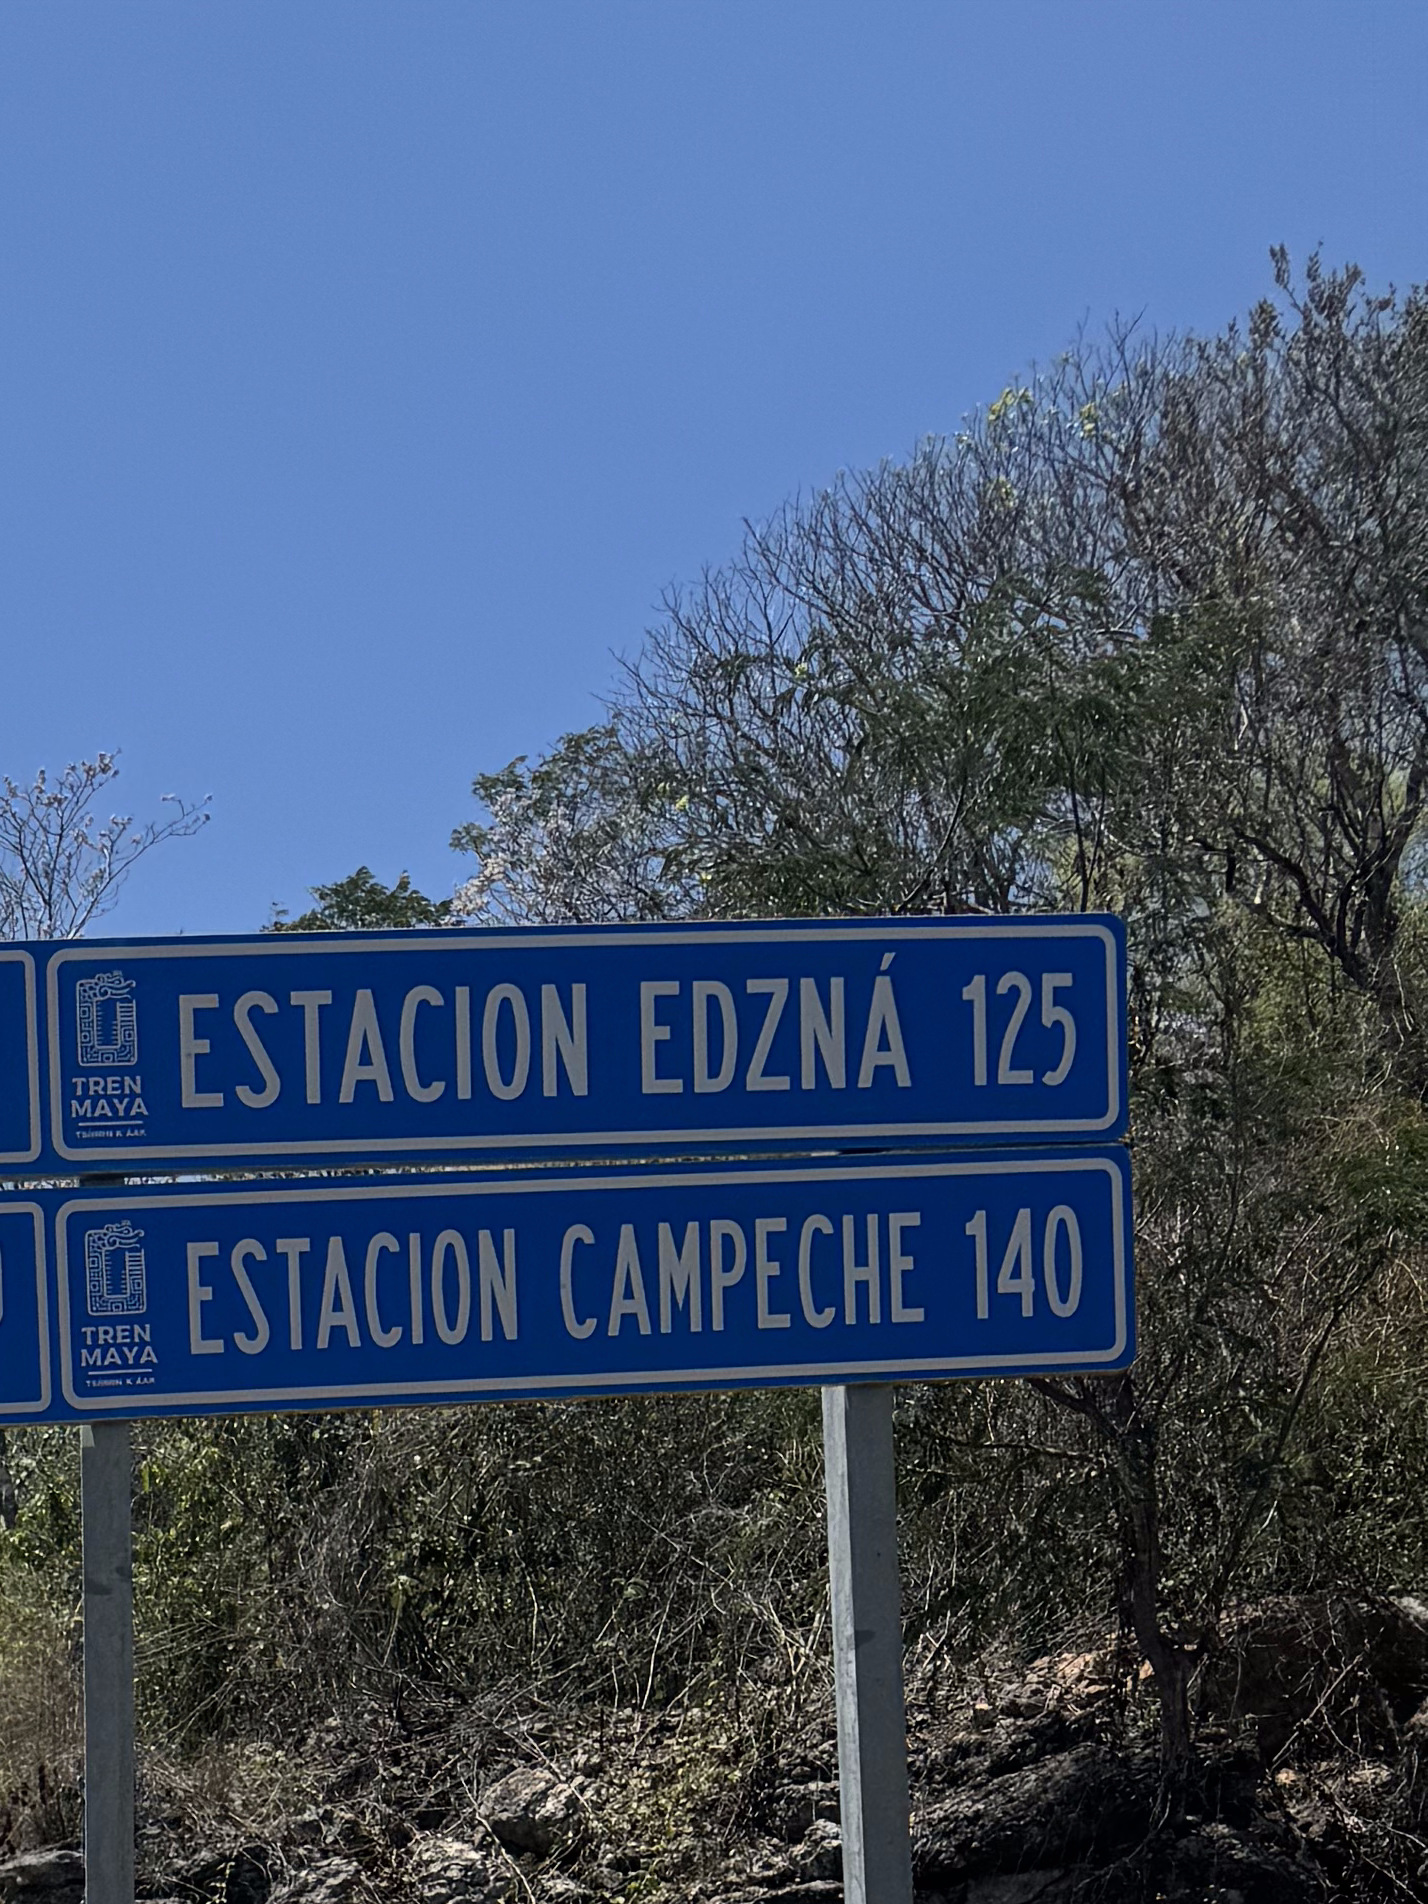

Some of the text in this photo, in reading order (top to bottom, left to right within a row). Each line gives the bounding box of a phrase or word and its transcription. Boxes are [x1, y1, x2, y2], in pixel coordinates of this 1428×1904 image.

[178, 952, 1076, 1109] ESTACION EDZNÁ 125
[71, 1075, 142, 1096] TREN
[70, 1097, 149, 1118] MAYA
[186, 1204, 1083, 1355] ESTACION CAMPECHE 140
[81, 1323, 151, 1345] TREN
[80, 1345, 158, 1367] MAYA
